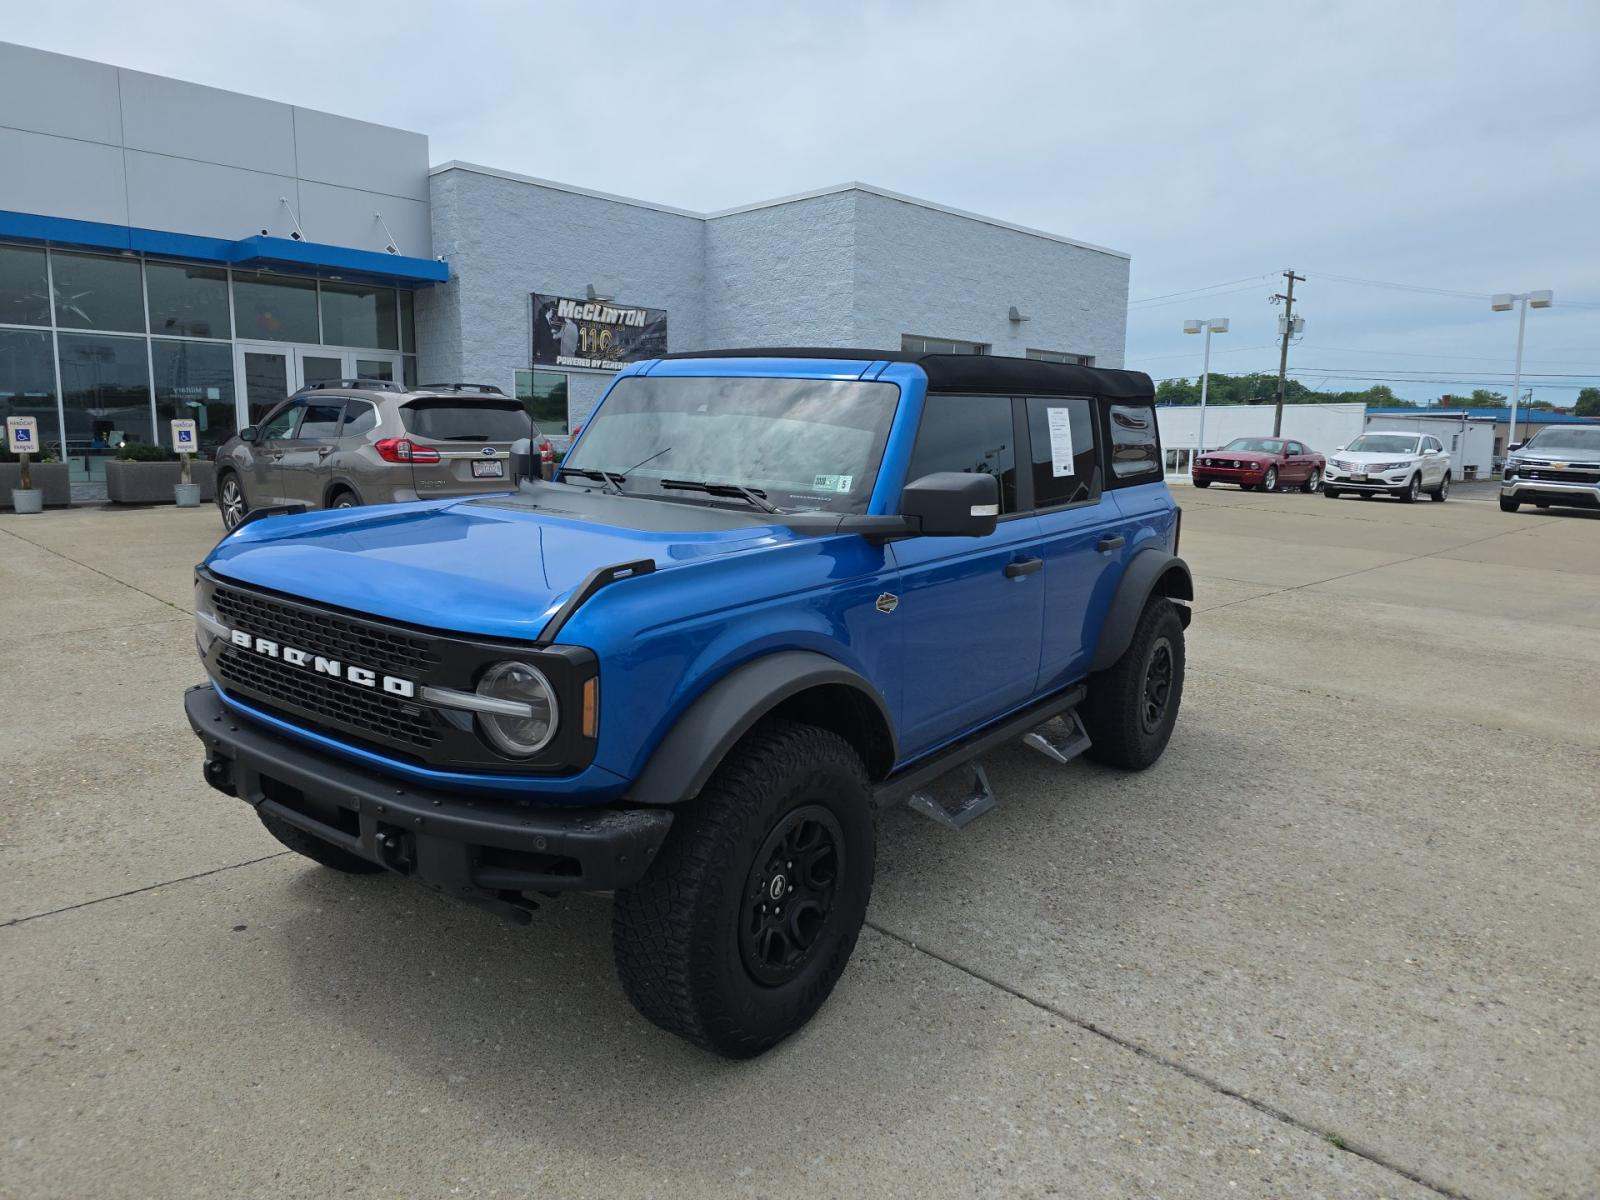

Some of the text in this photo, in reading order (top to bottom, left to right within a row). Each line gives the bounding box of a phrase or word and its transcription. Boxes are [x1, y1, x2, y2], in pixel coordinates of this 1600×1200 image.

[557, 299, 646, 327] McCLINTON
[556, 356, 591, 368] POWERED
[591, 359, 602, 368] BY
[231, 629, 415, 698] BRONCO
